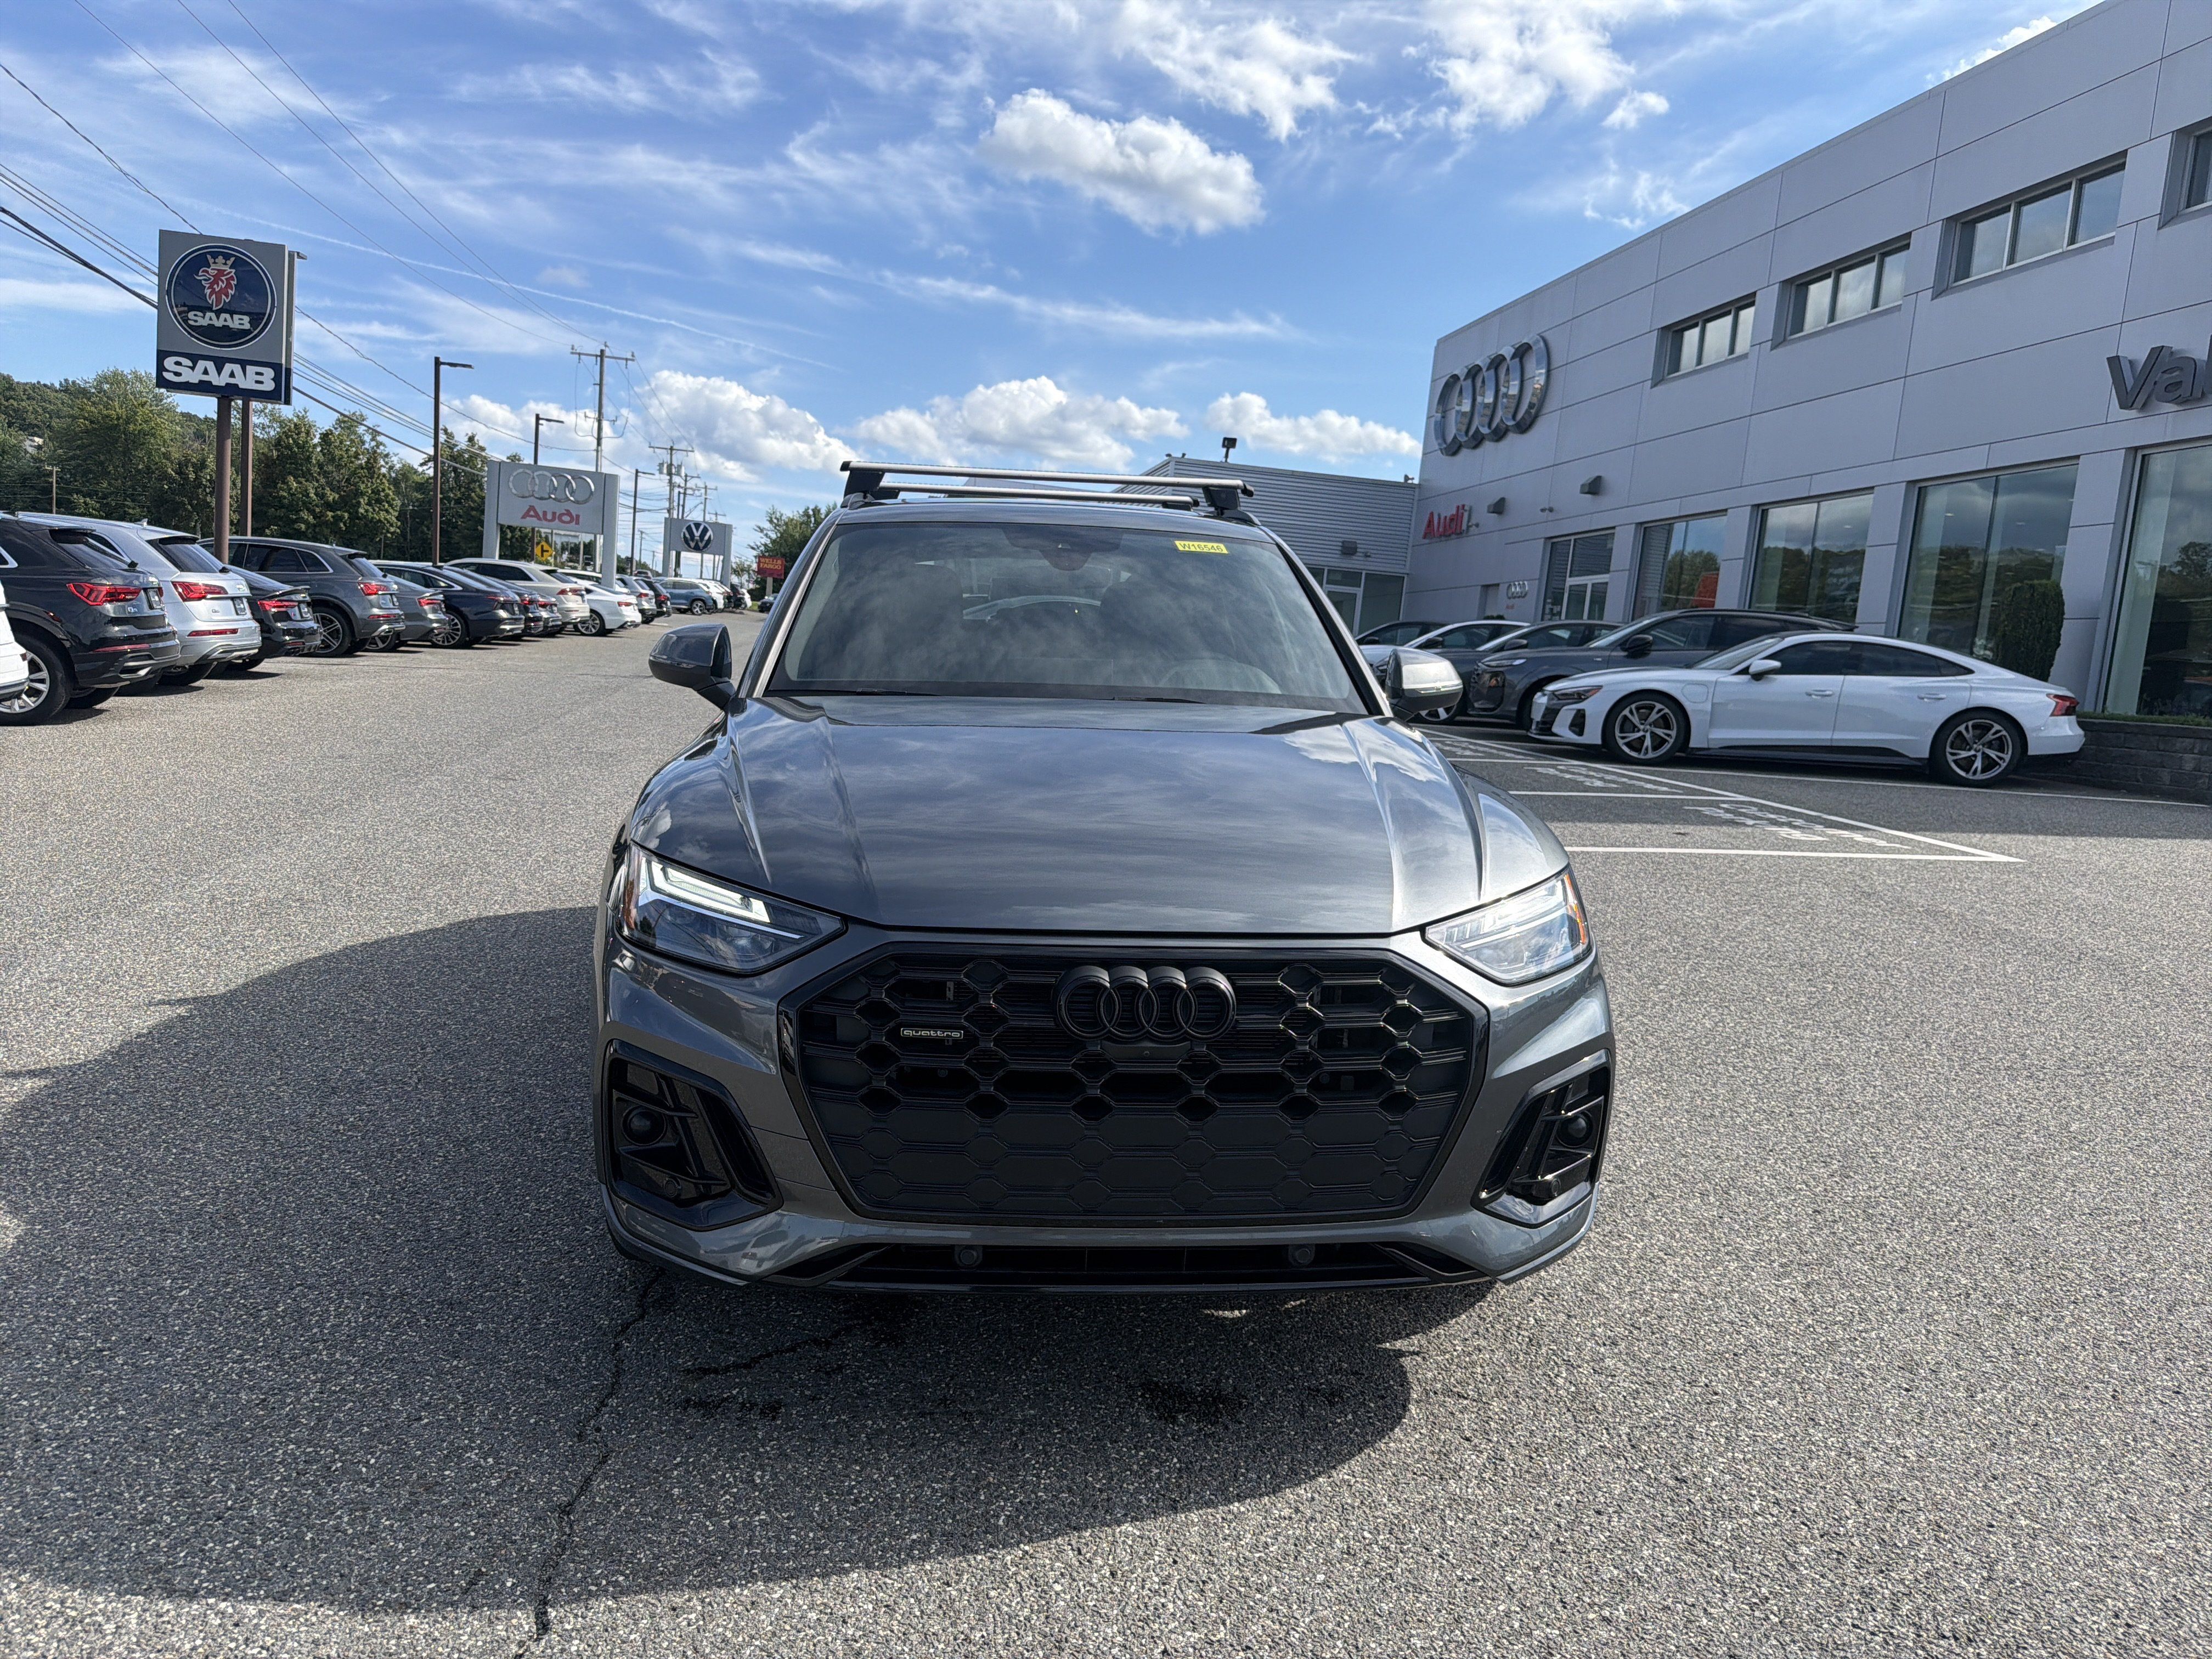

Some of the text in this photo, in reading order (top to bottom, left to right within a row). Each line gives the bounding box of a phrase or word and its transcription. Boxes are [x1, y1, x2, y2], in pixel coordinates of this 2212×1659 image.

[187, 311, 251, 330] SAAB
[162, 356, 275, 391] SAAB
[520, 505, 580, 525] Audi
[1422, 504, 1465, 539] Audi
[1179, 543, 1223, 552] W16546
